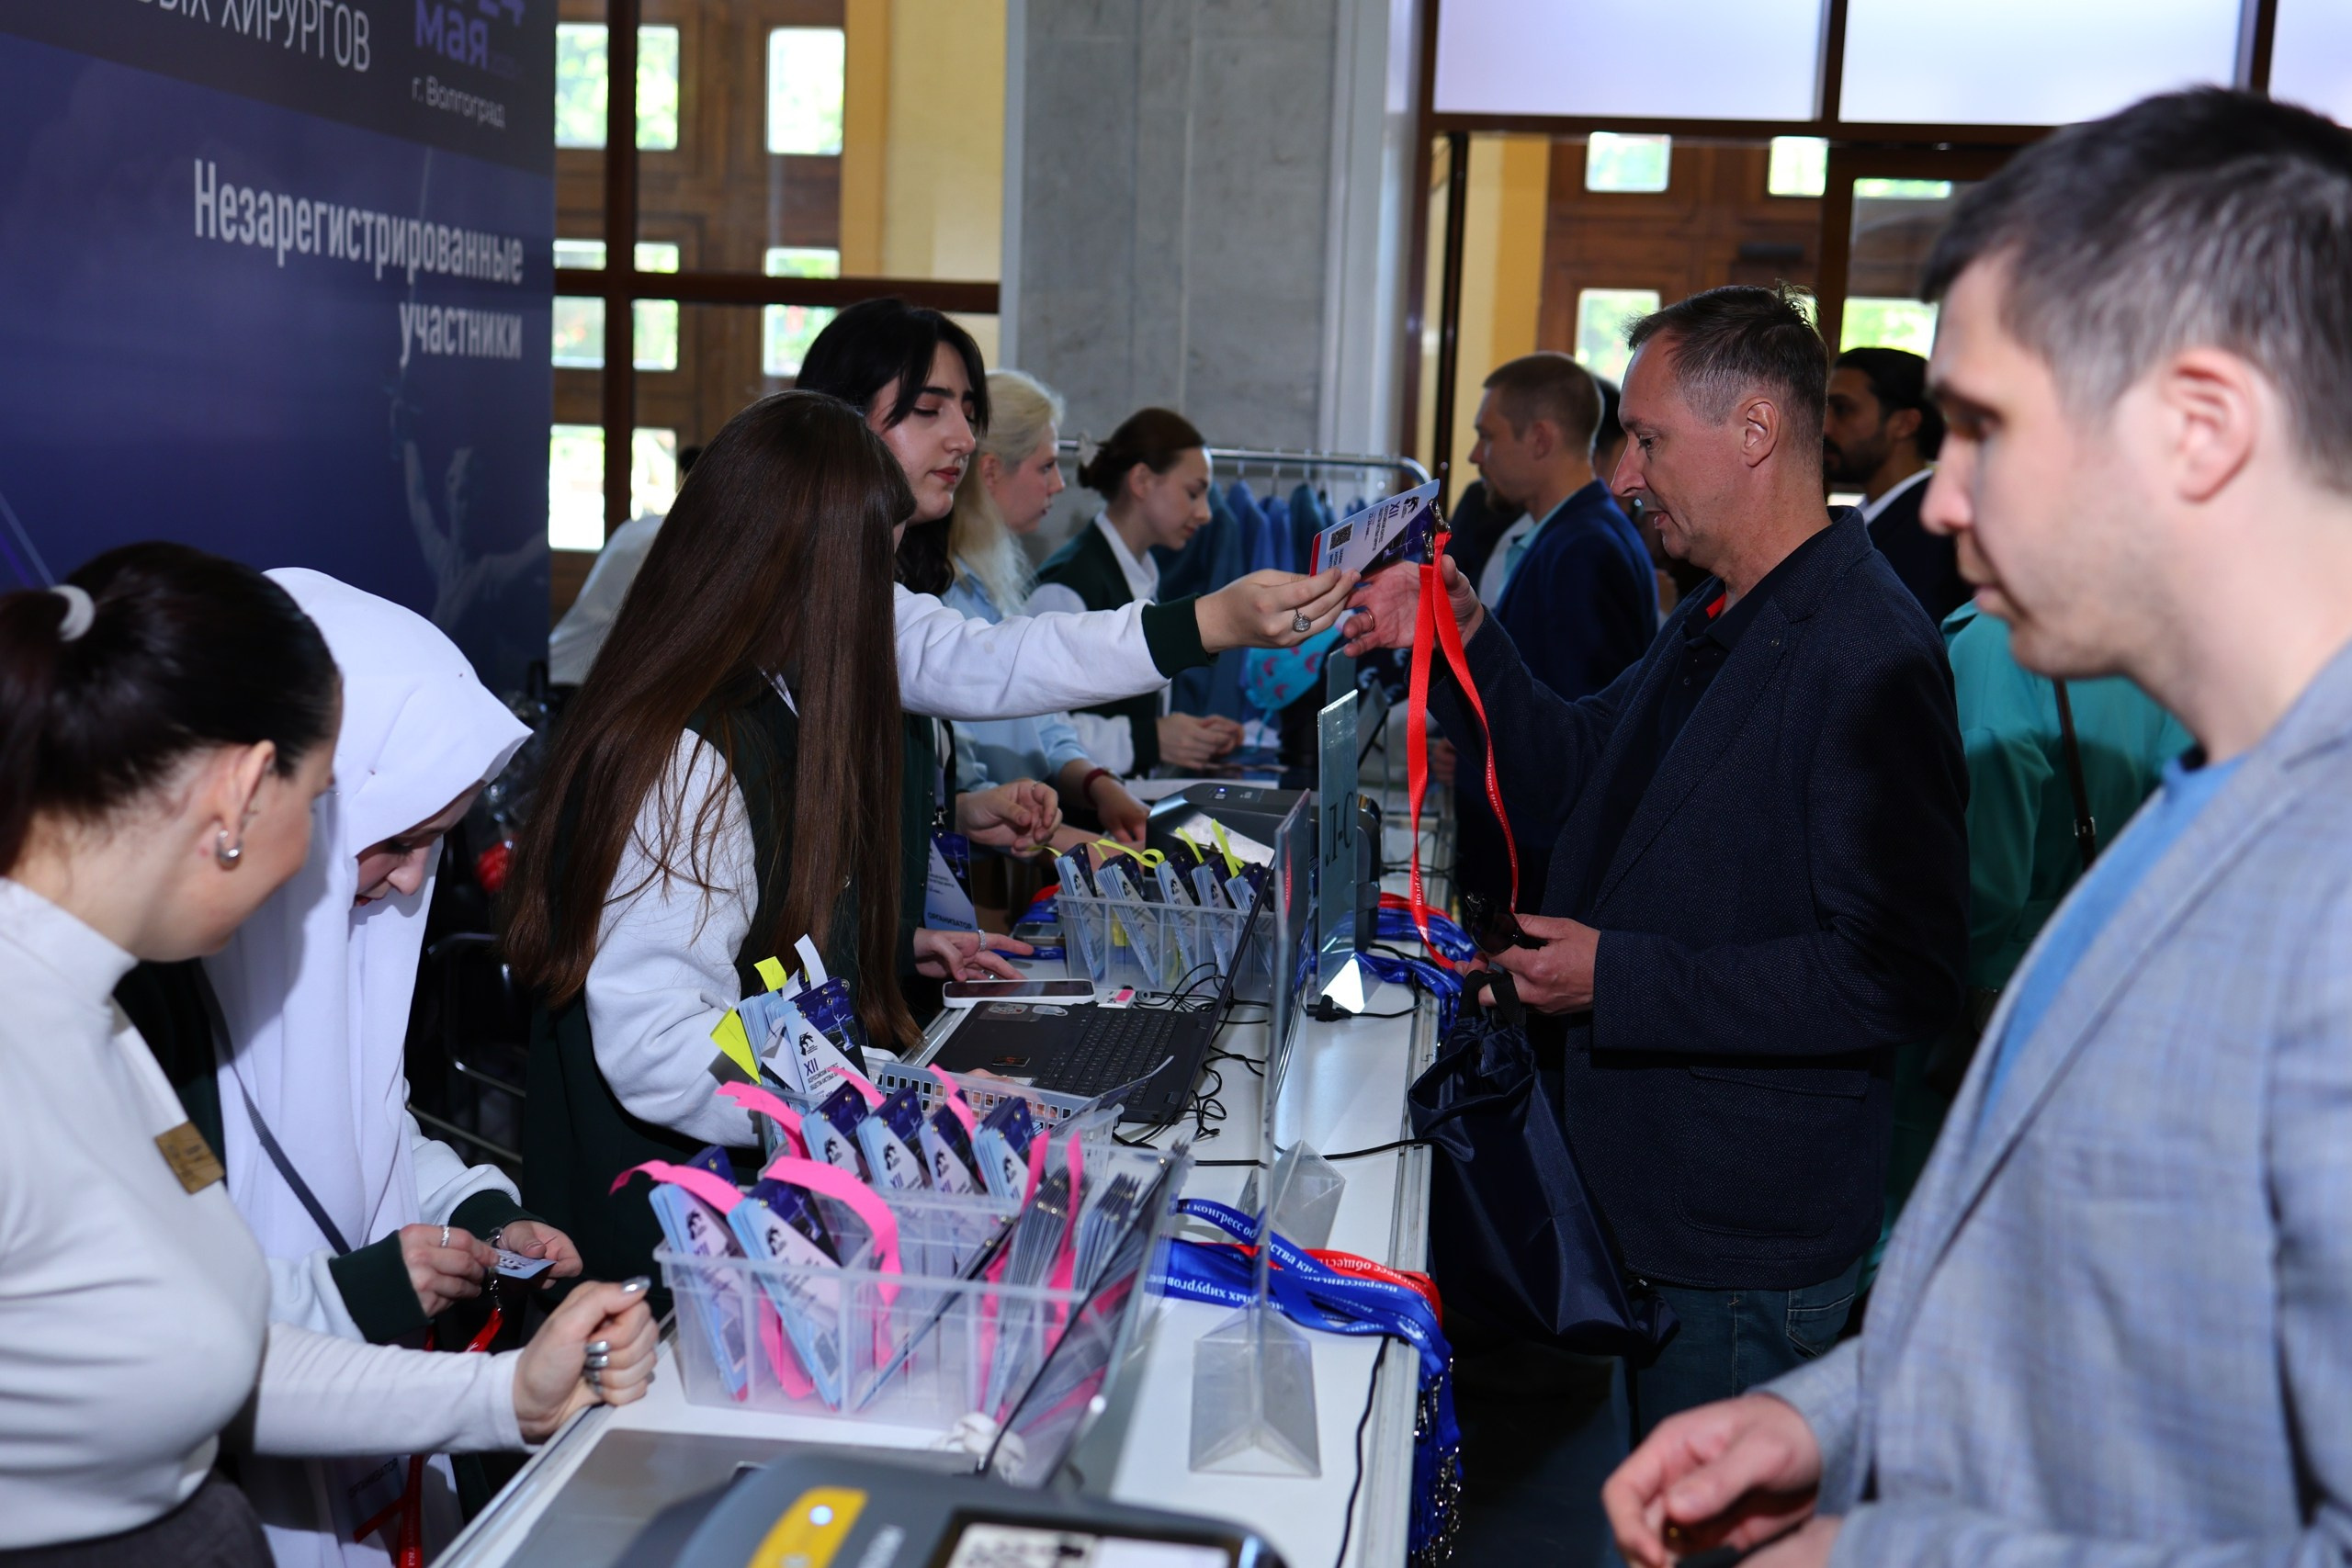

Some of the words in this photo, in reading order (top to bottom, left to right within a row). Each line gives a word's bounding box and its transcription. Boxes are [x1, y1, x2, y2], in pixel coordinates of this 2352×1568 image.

[425, 75, 506, 129] Волгоград
[194, 158, 523, 285] Незарегистрированные
[399, 301, 523, 367] участники
[803, 1057, 820, 1077] XII
[1193, 1203, 1244, 1232] конгресс
